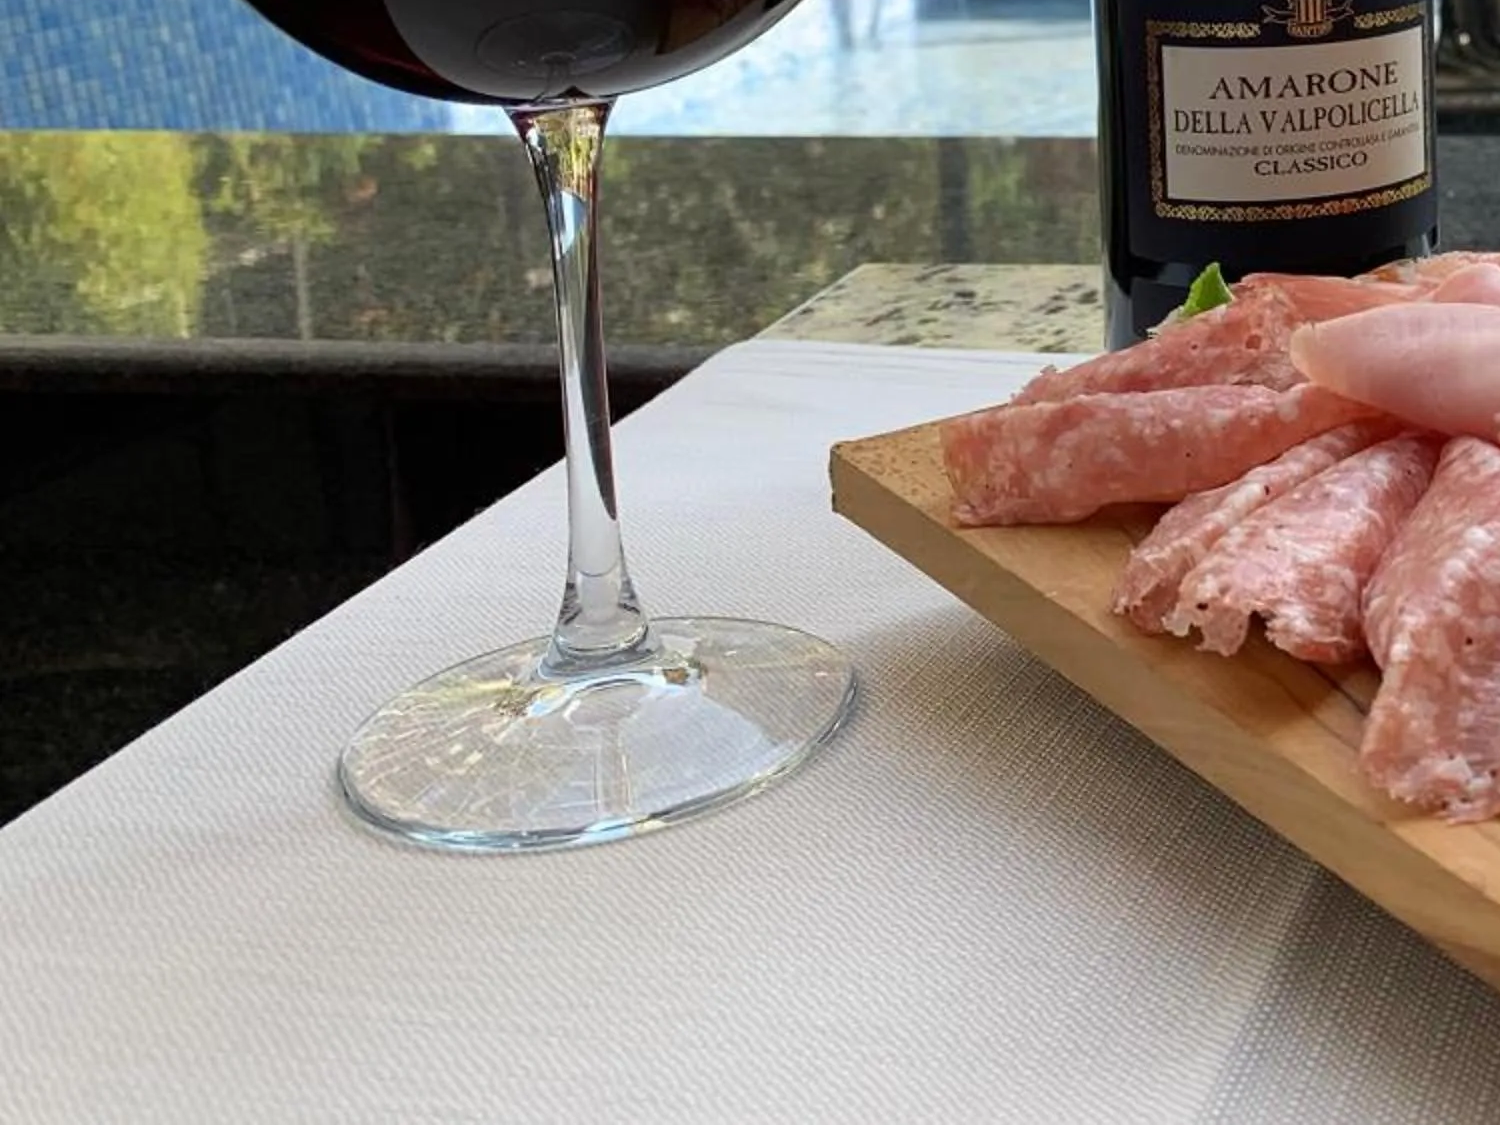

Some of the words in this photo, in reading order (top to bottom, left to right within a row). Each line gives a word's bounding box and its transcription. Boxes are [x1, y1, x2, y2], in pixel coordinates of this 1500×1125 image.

[1209, 61, 1399, 100] AMARONE
[1174, 109, 1252, 135] DELLA
[1259, 90, 1420, 134] VALPOLICELLA
[1175, 143, 1260, 157] DENOMINAZIONE
[1263, 144, 1273, 156] DI
[1254, 150, 1368, 176] CLASSICO
